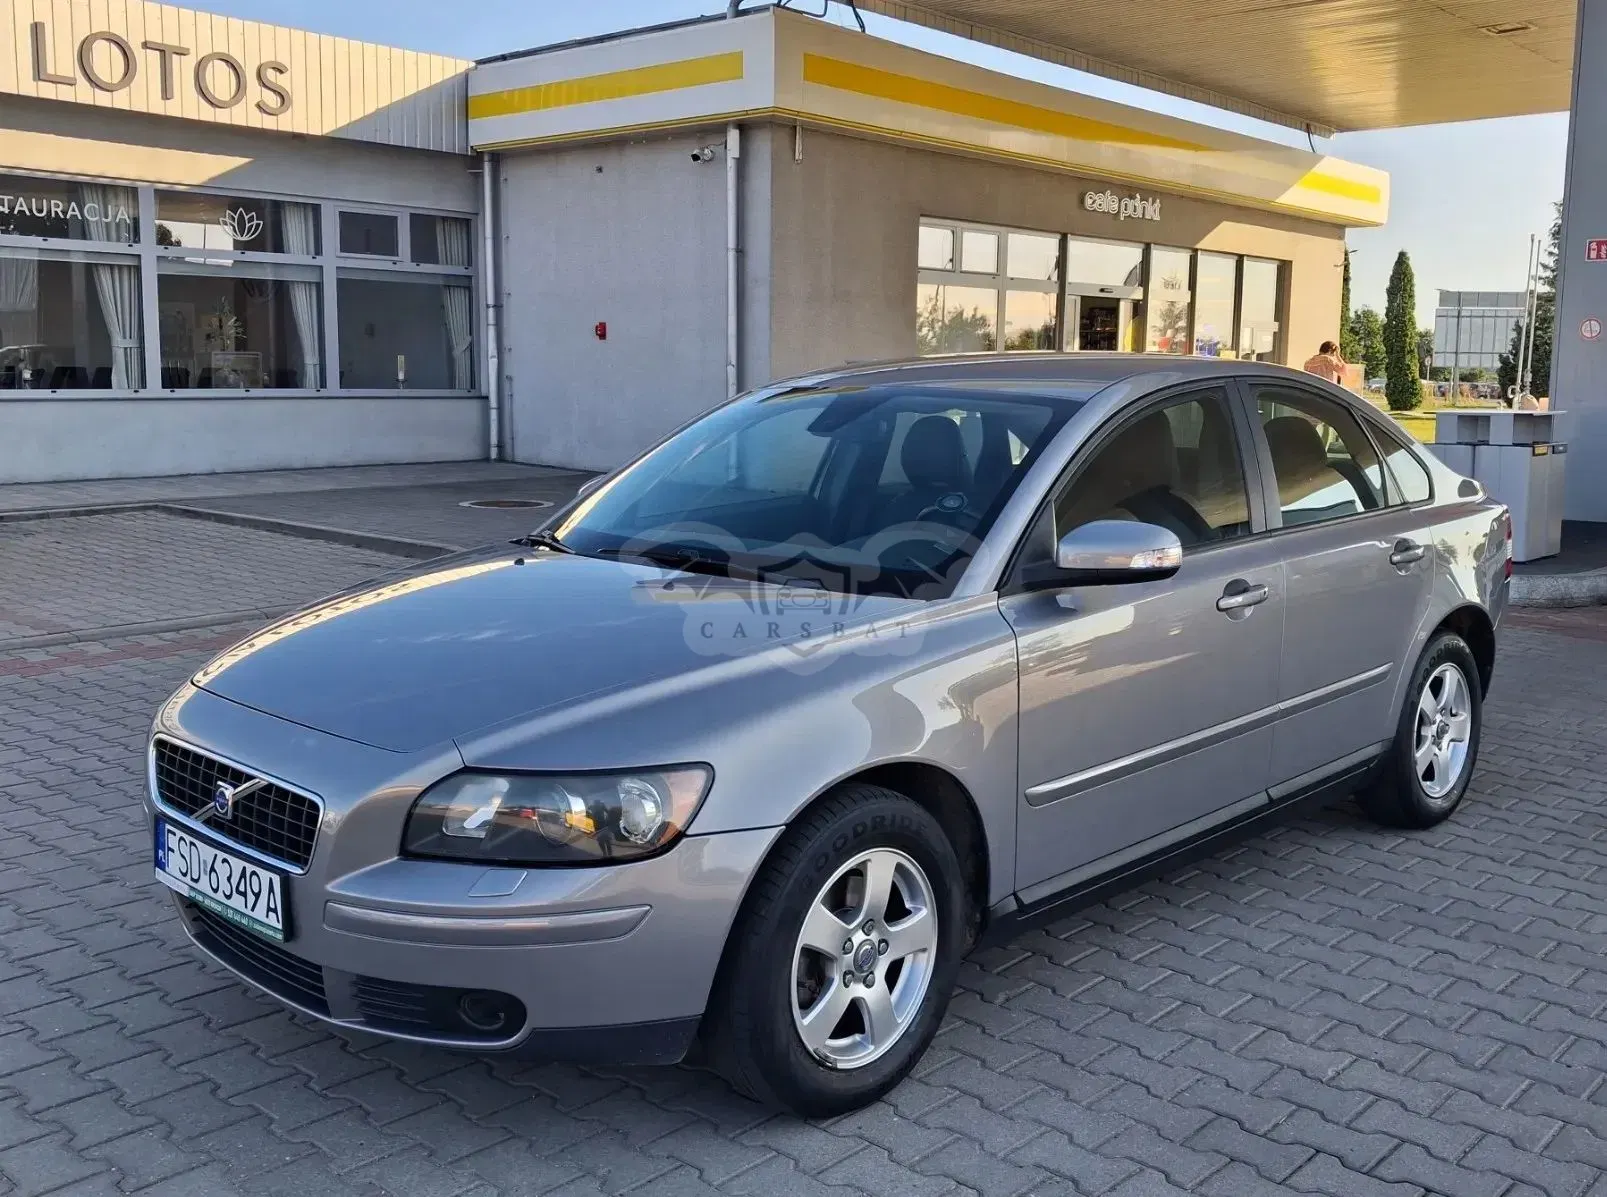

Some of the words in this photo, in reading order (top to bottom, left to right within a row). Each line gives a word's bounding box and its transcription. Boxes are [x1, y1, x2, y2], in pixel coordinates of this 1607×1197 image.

[31, 21, 292, 116] LOTOS
[1085, 190, 1119, 214] cafe
[166, 829, 201, 883] FSD
[208, 853, 281, 924] 6349A
